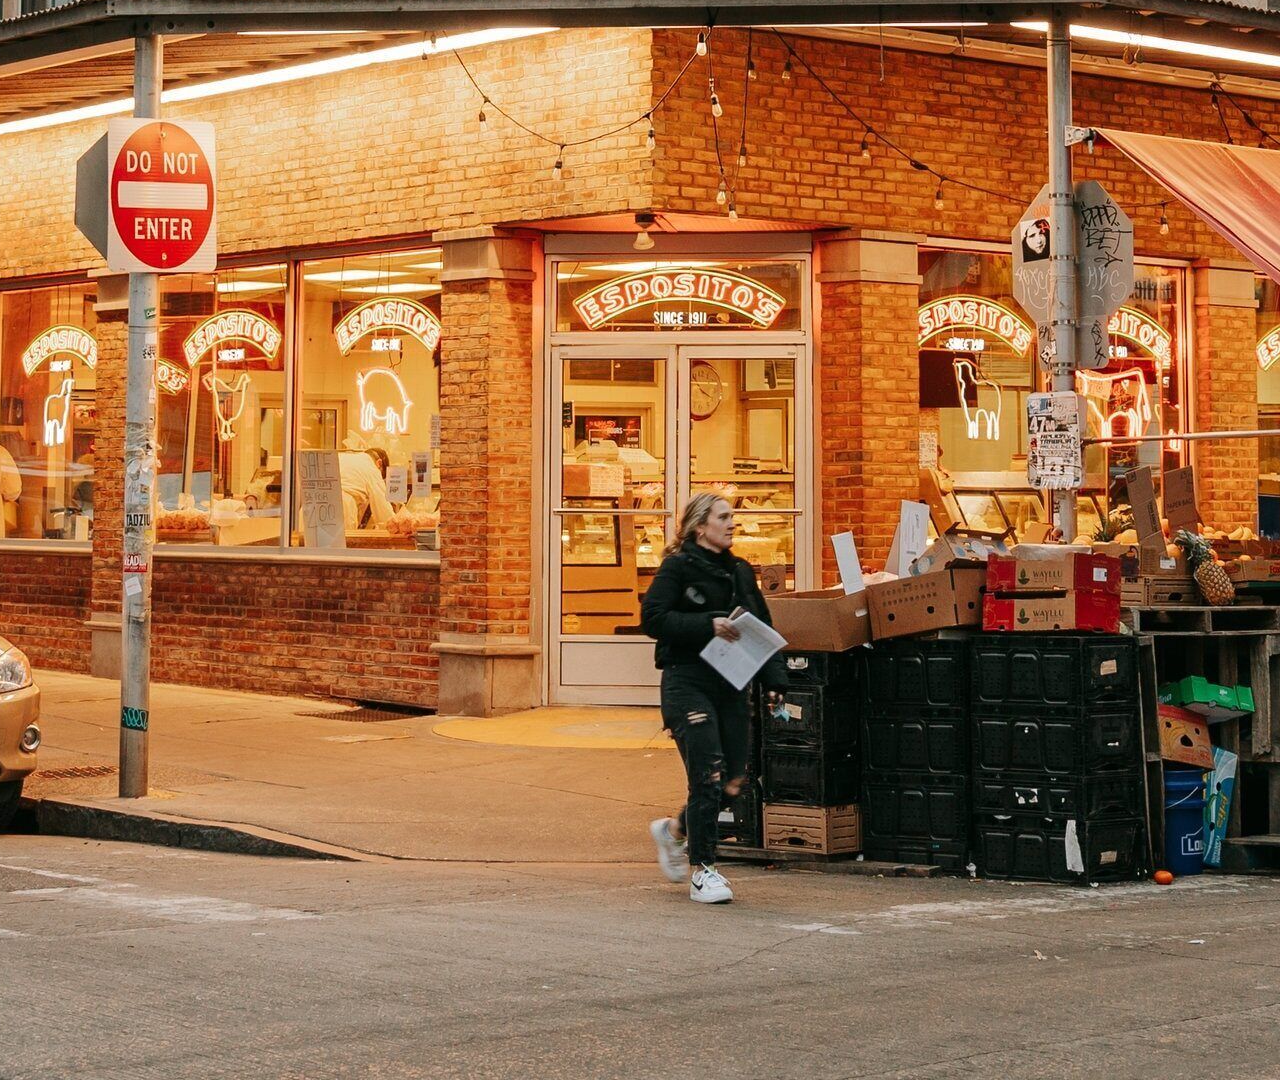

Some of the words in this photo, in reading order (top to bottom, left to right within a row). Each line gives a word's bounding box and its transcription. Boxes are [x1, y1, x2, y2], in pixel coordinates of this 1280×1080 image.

[126, 150, 151, 173] DO
[163, 152, 199, 175] NOT
[134, 217, 192, 240] ENTER
[579, 273, 781, 325] ESPOSITO'S
[337, 301, 441, 350] ESPOSITO'S
[654, 311, 684, 324] SINCE
[688, 311, 707, 324] 1911
[918, 300, 1031, 351] SPOSITO'S
[187, 315, 279, 361] ESPOSITO'S
[301, 451, 336, 480] SALE
[1032, 570, 1063, 582] WAYLLU
[1032, 608, 1065, 621] WAYLLU
